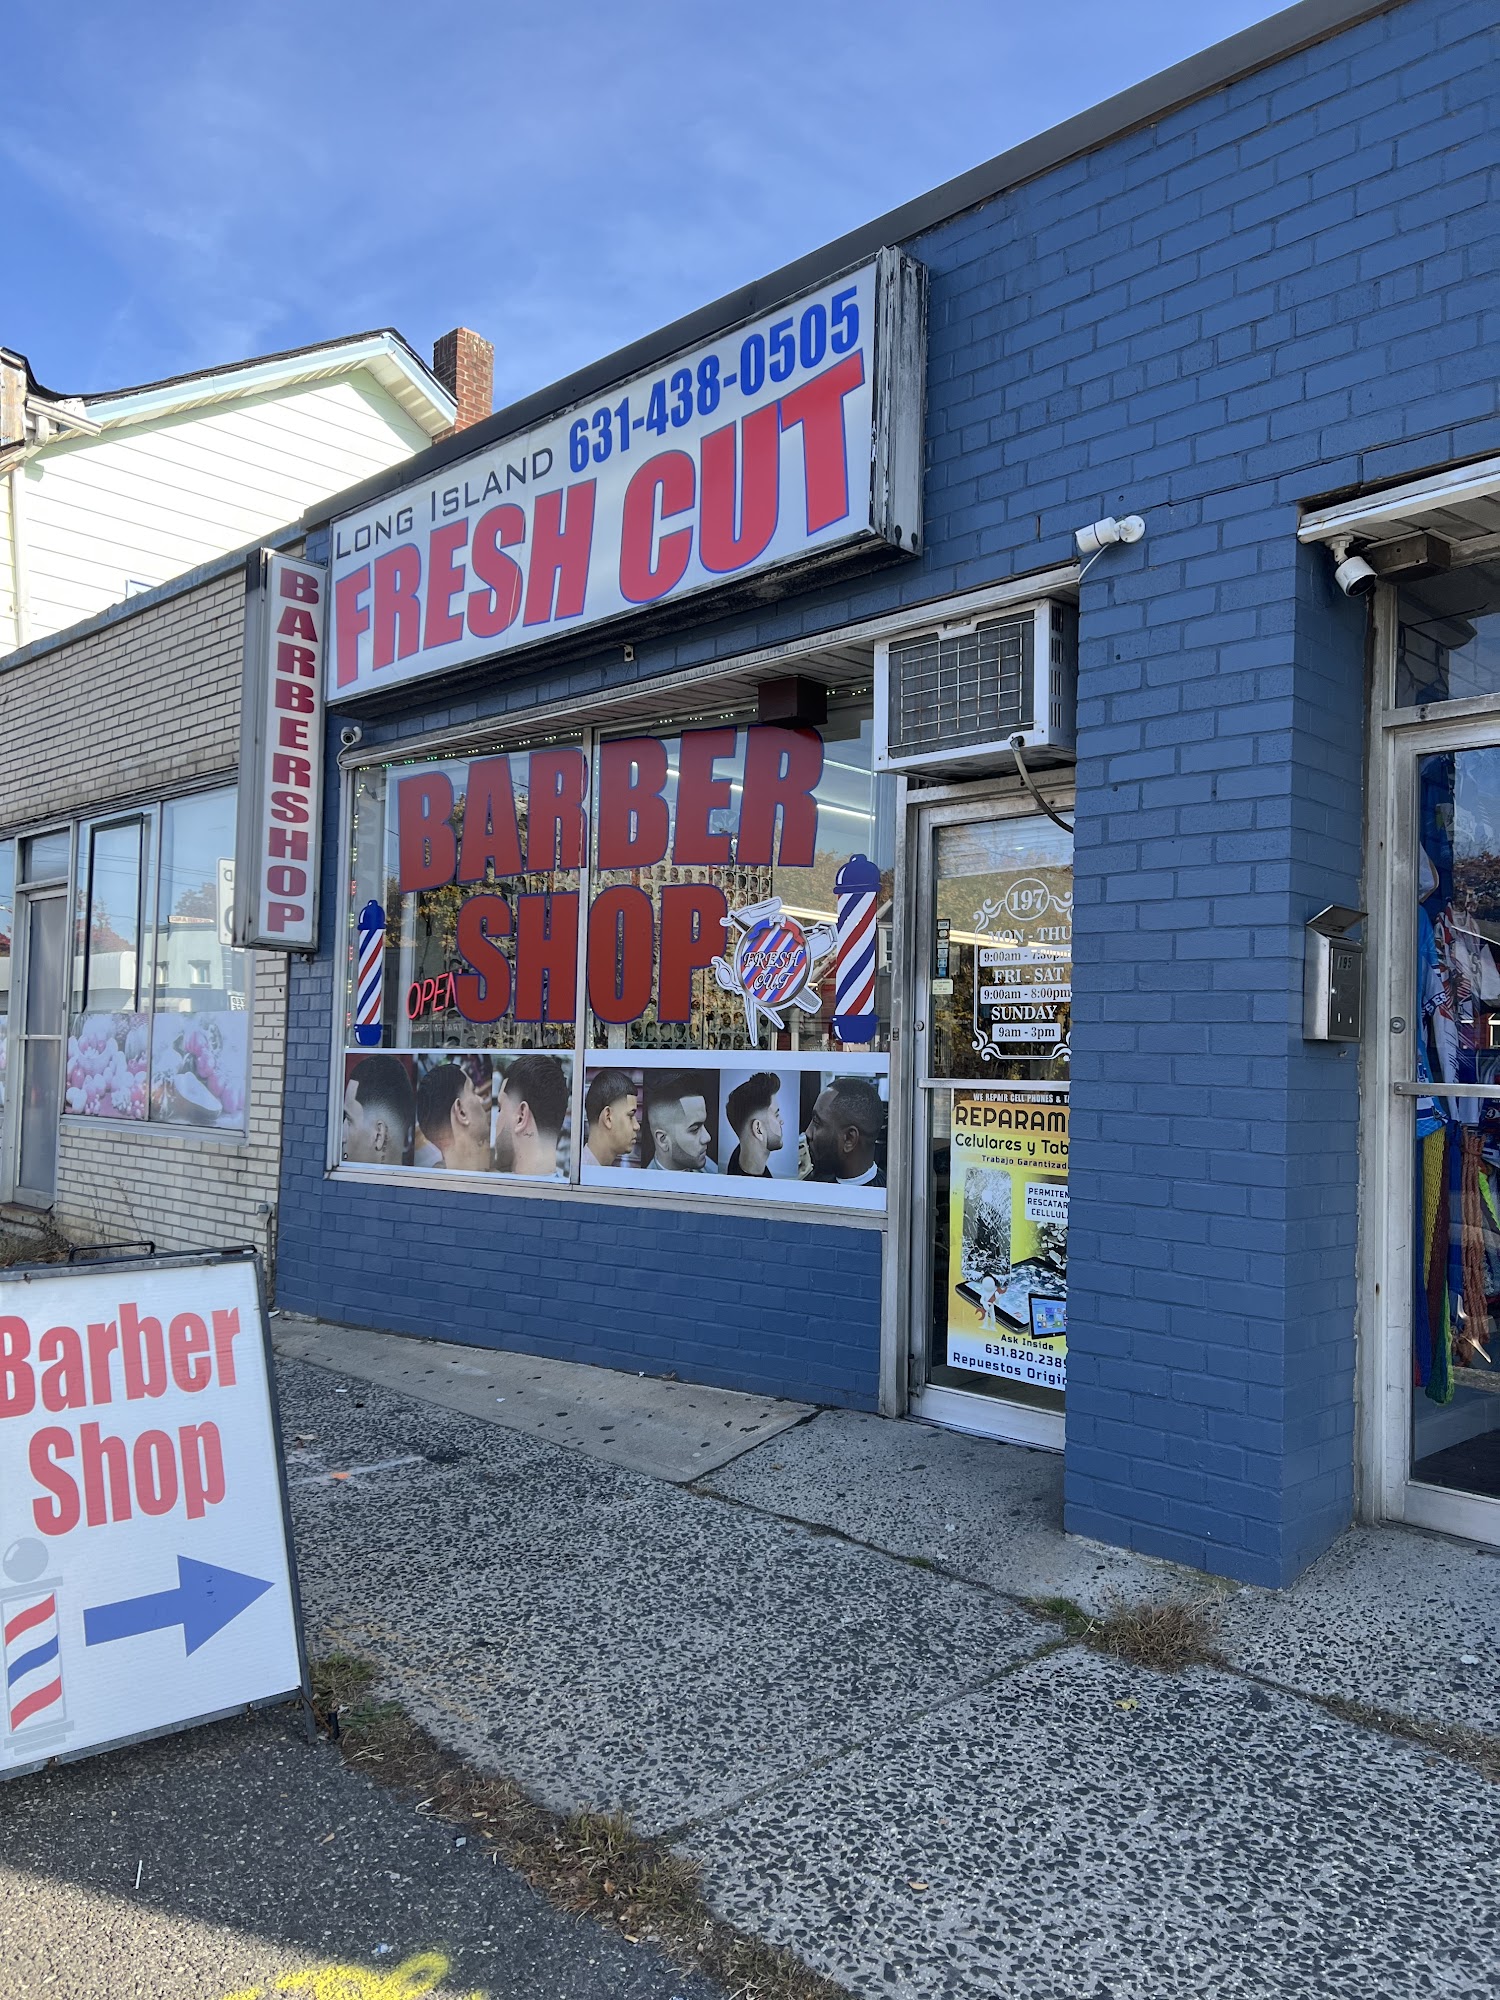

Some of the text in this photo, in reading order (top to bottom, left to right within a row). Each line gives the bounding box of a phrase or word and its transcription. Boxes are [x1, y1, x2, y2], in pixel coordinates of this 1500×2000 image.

[569, 286, 860, 473] 631-438-0505
[336, 348, 866, 689] FRESH CUT
[267, 567, 319, 932] BARBERSHOP
[399, 725, 824, 893] BARBER
[1011, 889, 1045, 911] 197
[988, 929, 1025, 943] MON
[455, 883, 728, 1024] SHOP
[744, 950, 803, 968] FRESH
[984, 951, 1021, 962] 9:00am
[1031, 949, 1071, 961] 7:30p
[1339, 956, 1352, 969] 195
[752, 972, 794, 990] CUT
[993, 969, 1022, 984] FRI
[1034, 967, 1064, 982] SAT
[406, 968, 462, 1020] OPEN
[984, 989, 1021, 1000] 9:00am
[1031, 987, 1071, 1000] 8:00pm
[991, 1005, 1057, 1020] SUNDAY
[999, 1027, 1021, 1037] 9am
[1031, 1026, 1055, 1039] 3pm
[973, 1093, 984, 1101] WE
[986, 1093, 1008, 1102] REPAIR
[1011, 1094, 1024, 1102] CELL
[1027, 1094, 1053, 1103] PHONES
[955, 1106, 1066, 1132] REPARAM
[955, 1133, 1068, 1156] Celulares y Tab
[982, 1155, 1068, 1169] Trabajo Garantizad
[1028, 1188, 1069, 1198] PERMITEN
[1027, 1198, 1068, 1208] RESCATAR
[1032, 1209, 1068, 1219] CELLLUL
[1001, 1334, 1054, 1351] Ask Inside
[0, 1302, 241, 1419] Barber
[953, 1352, 1021, 1375] Repuestos
[28, 1420, 226, 1537] Shop
